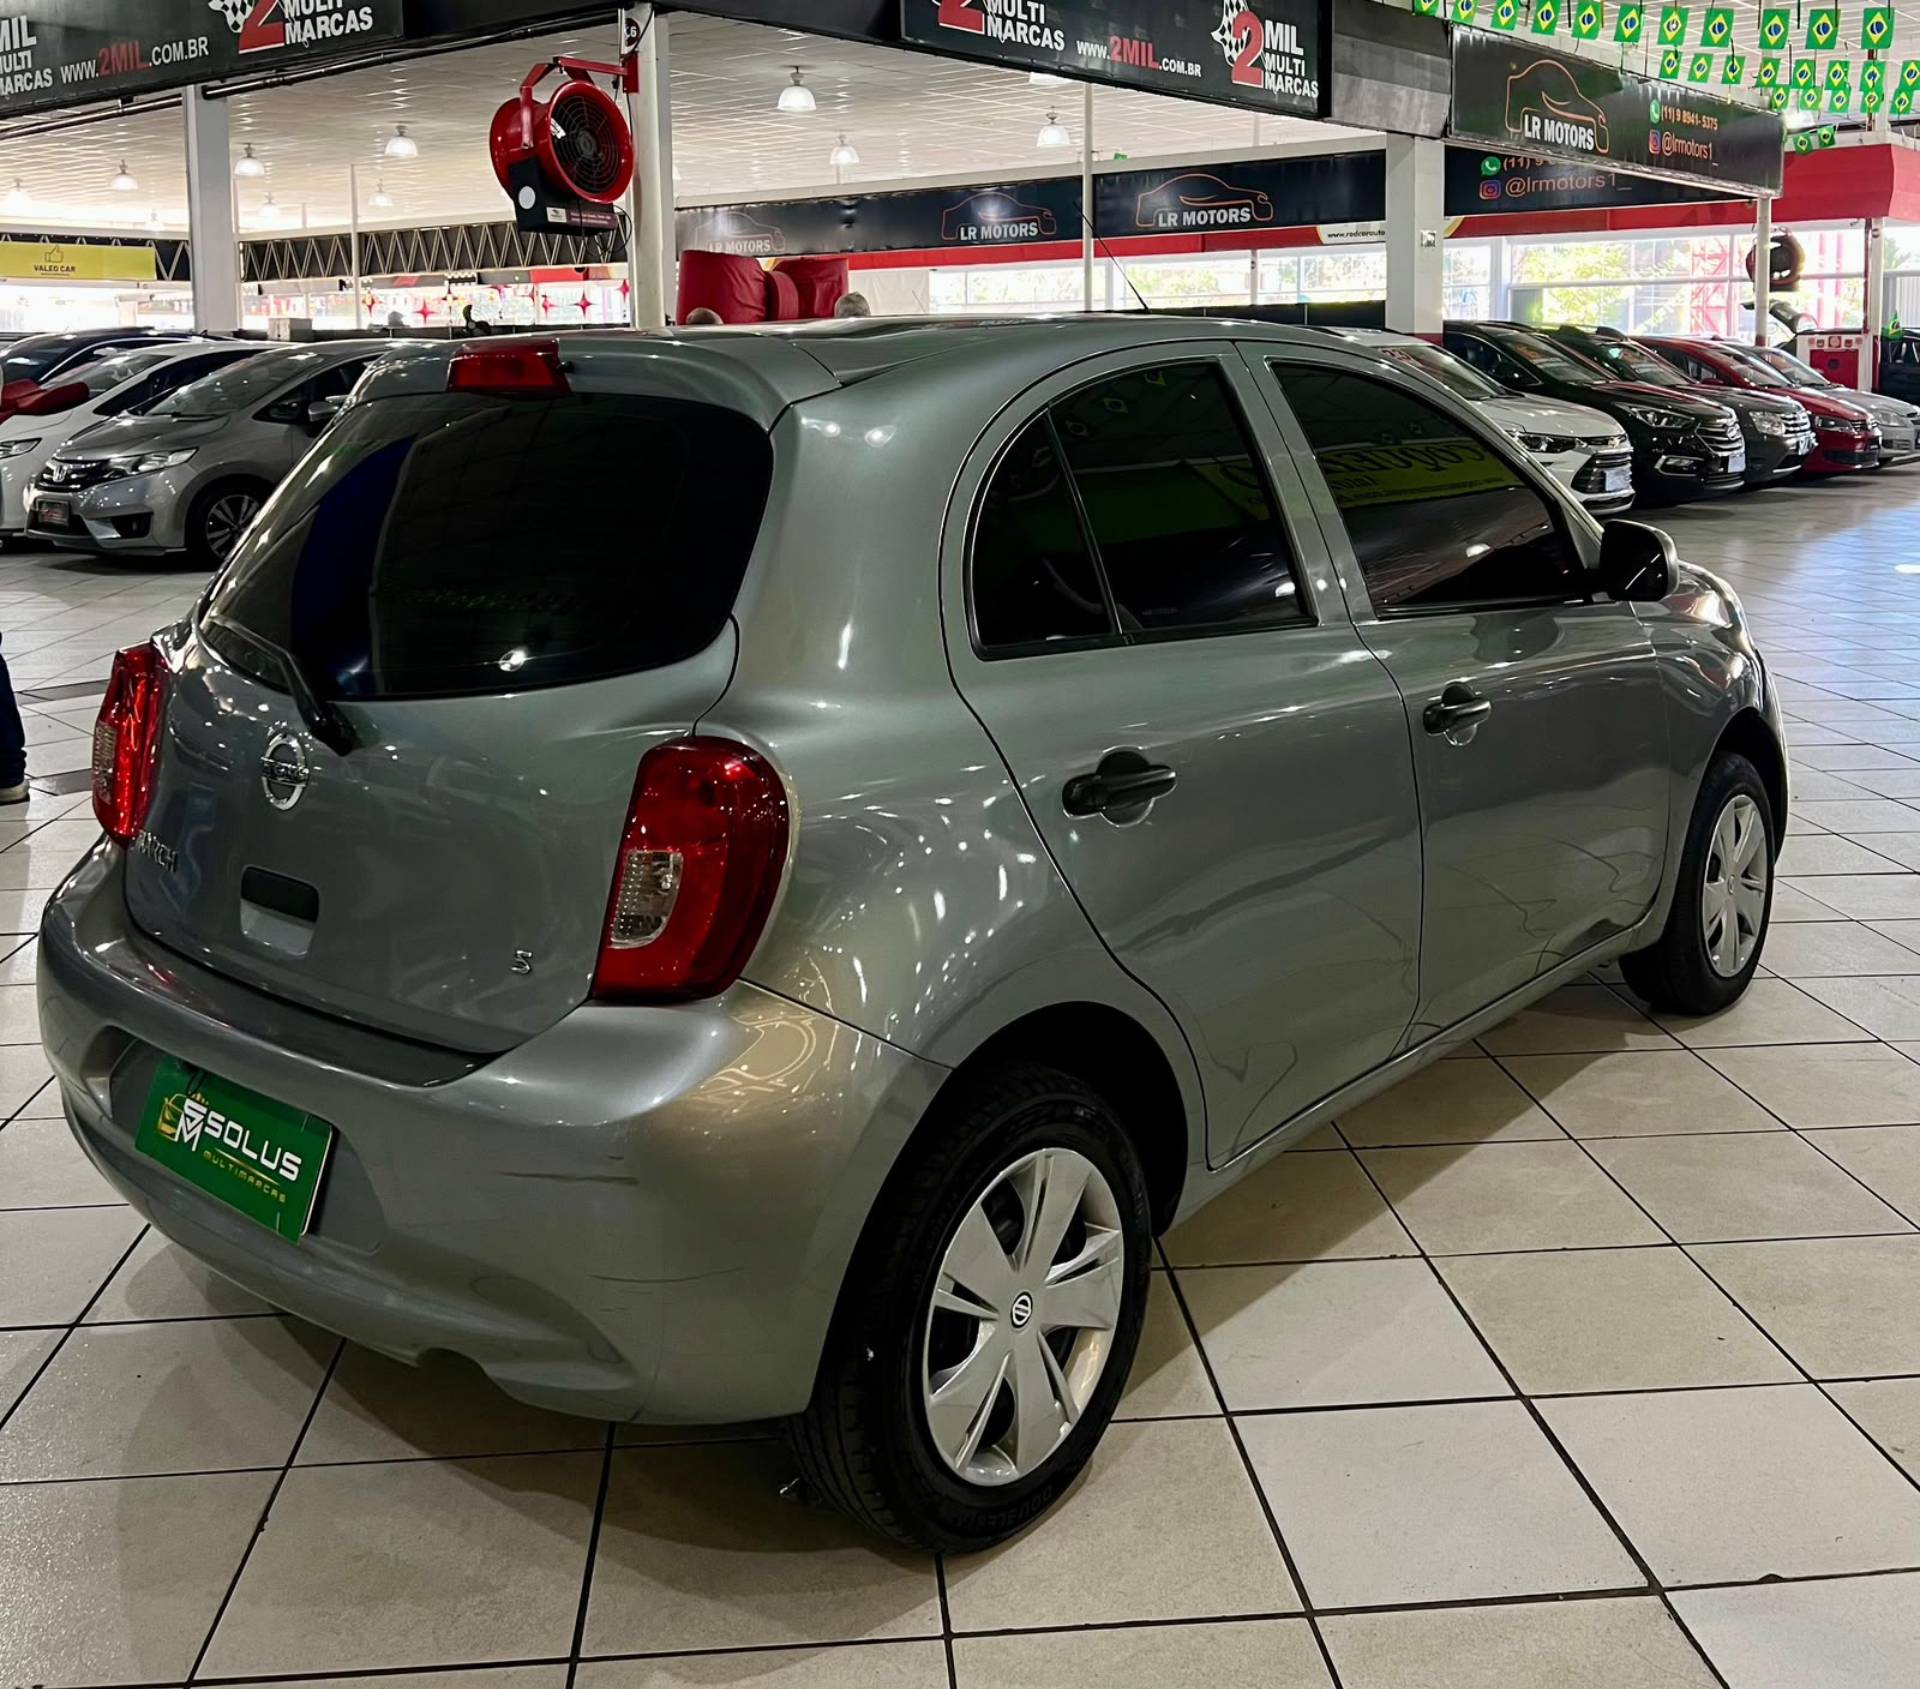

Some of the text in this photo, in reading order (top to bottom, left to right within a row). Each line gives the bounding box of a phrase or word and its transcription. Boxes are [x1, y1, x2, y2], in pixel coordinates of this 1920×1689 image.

[988, 0, 1045, 24] MULTI
[285, 6, 373, 46] MARCAS
[987, 15, 1065, 52] MARCAS
[0, 50, 32, 74] ULTI
[60, 36, 209, 84] WWW.2MIL.COM.BR
[1076, 35, 1202, 77] WWW.2MIL.COM.BR
[1232, 10, 1304, 88] 2 MIL
[1265, 52, 1305, 77] MULTI
[1265, 71, 1319, 98] MARCAS
[1524, 114, 1595, 151] LR MOTORS
[1158, 207, 1251, 227] LR MOTORS
[960, 221, 1038, 241] LR MOTORS
[725, 239, 770, 253] MOTORS
[511, 949, 533, 974] S
[204, 1110, 302, 1182] SOLUS
